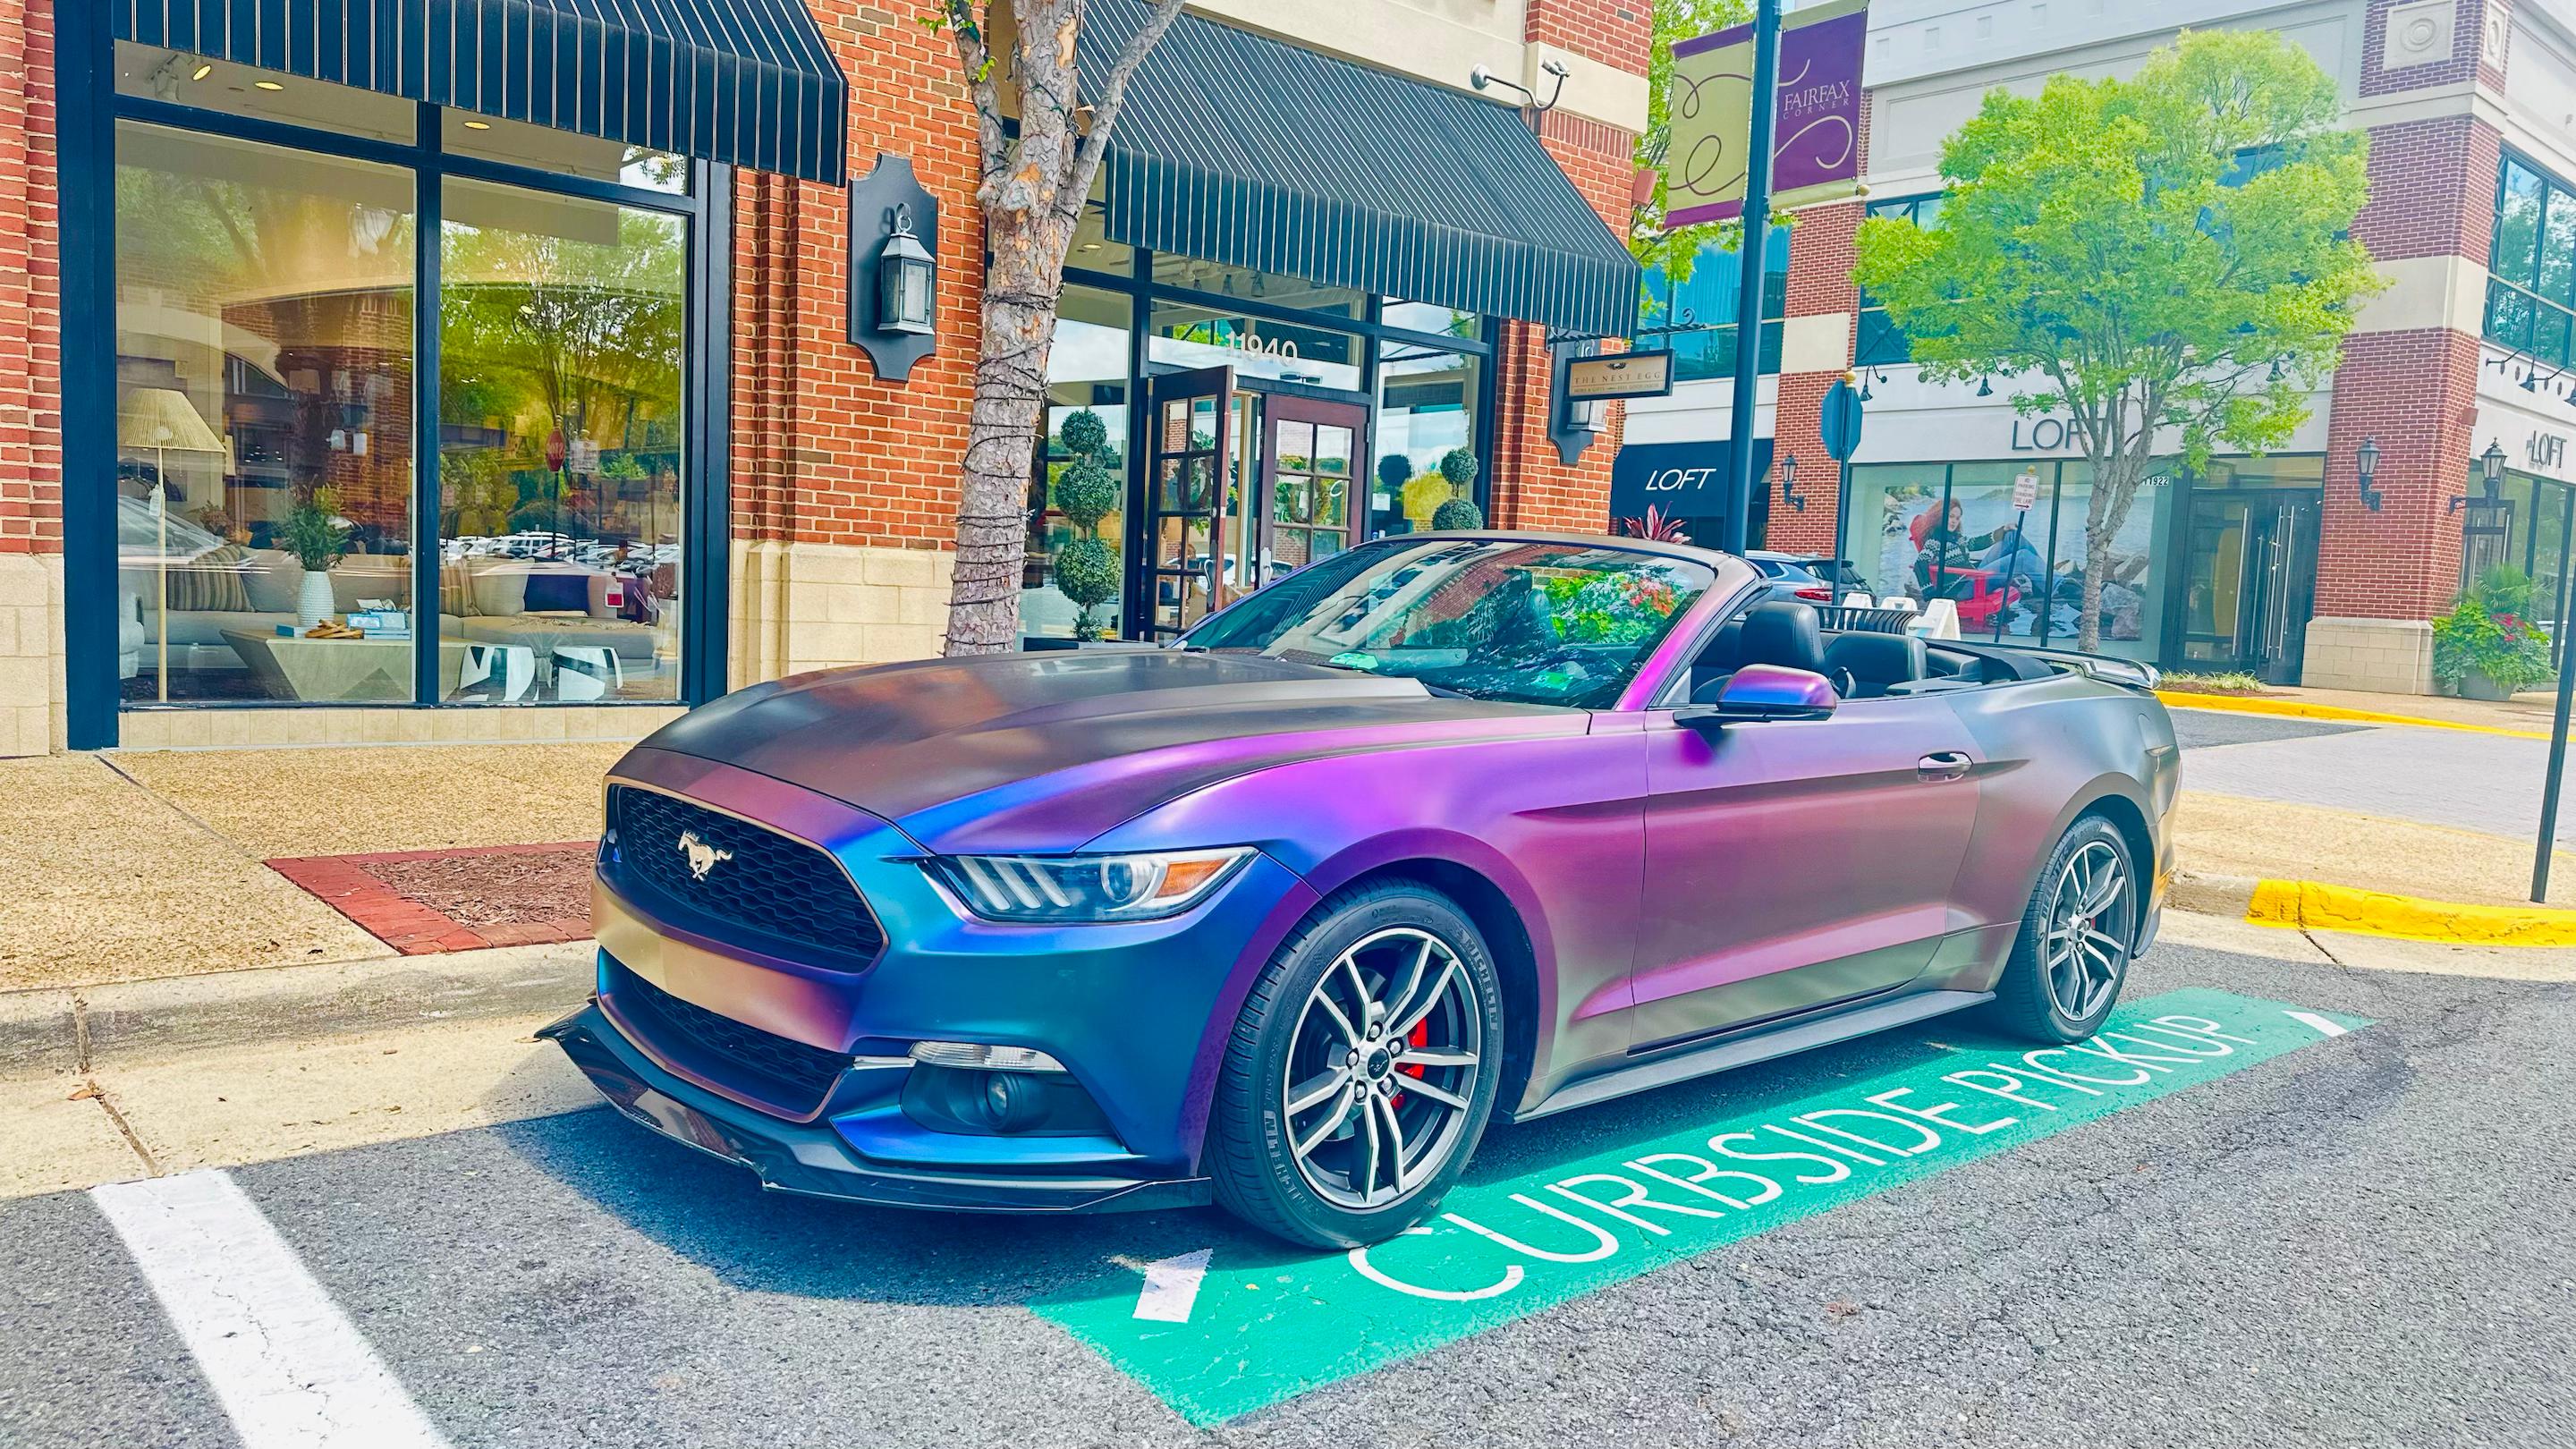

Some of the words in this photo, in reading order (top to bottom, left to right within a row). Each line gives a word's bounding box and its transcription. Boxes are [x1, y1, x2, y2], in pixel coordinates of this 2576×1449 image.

[1783, 98, 1849, 120] CORNER
[1784, 80, 1850, 111] FAIRFAX
[1225, 331, 1298, 367] 11940
[1574, 377, 1597, 385] THE
[1602, 373, 1631, 382] NEST
[1638, 371, 1661, 380] EGG
[2012, 418, 2106, 450] LOF
[2530, 430, 2568, 469] LOFT
[1645, 468, 1716, 490] LOFT
[1465, 937, 1497, 1025] MICHELIN
[1264, 1115, 1307, 1204] MICHELIN
[1349, 1088, 2020, 1301] CURBSIDE
[1940, 1015, 2258, 1110] PICKUP
